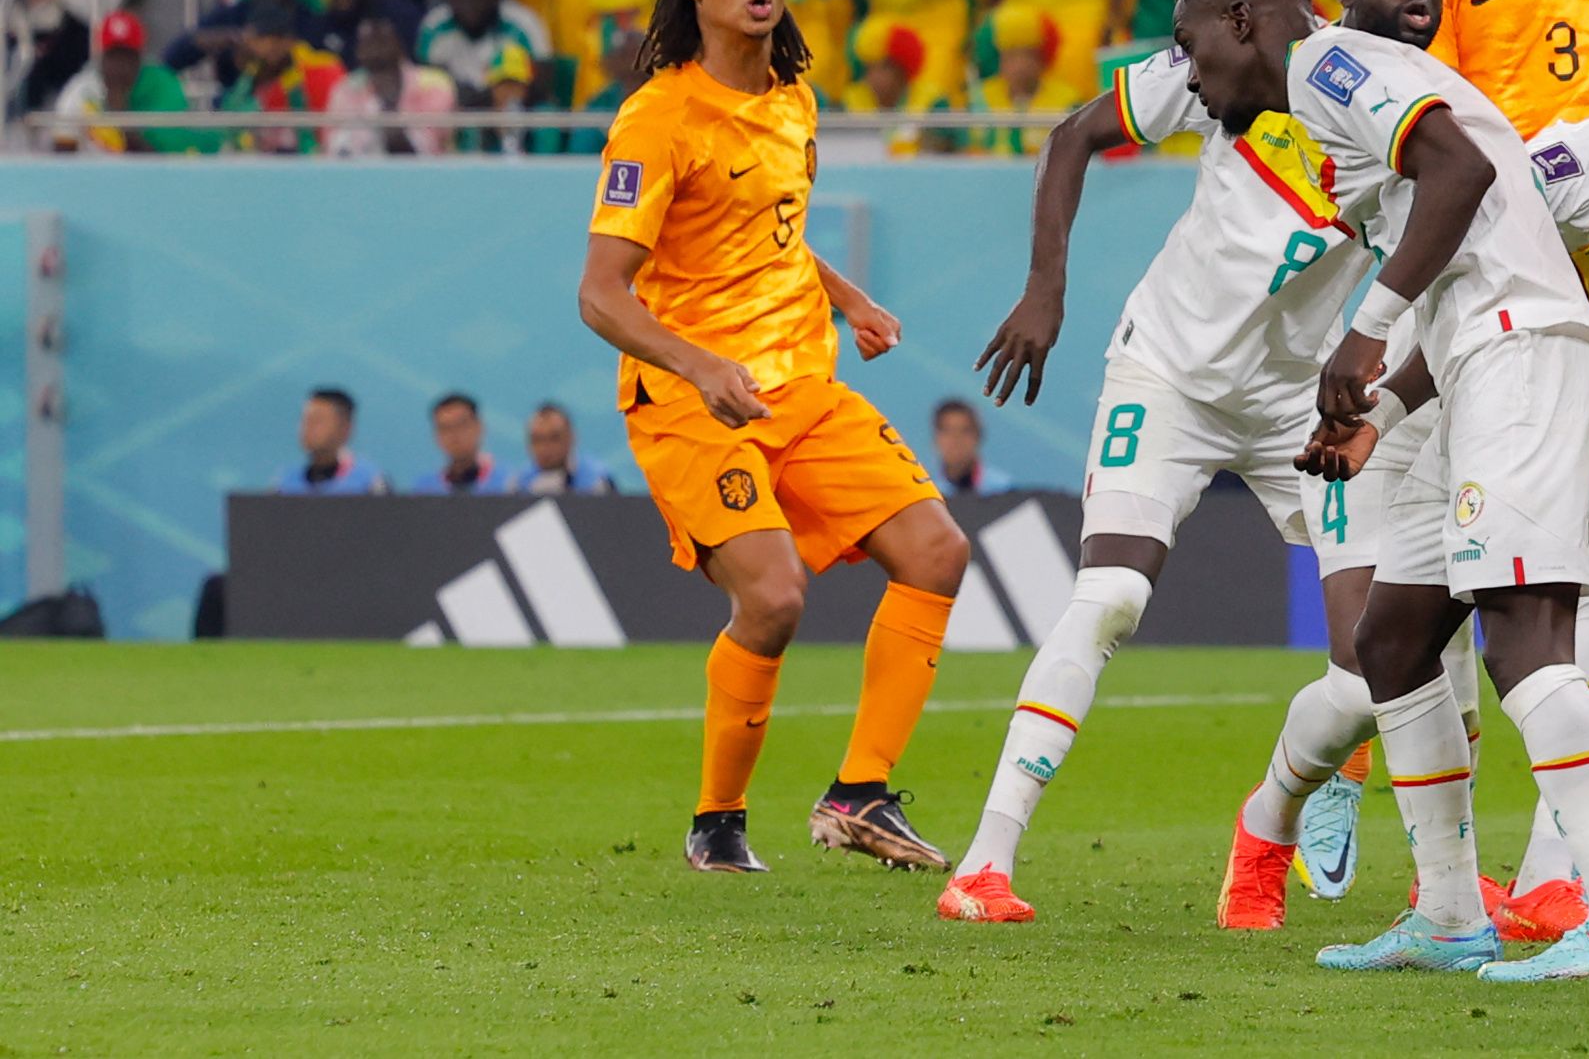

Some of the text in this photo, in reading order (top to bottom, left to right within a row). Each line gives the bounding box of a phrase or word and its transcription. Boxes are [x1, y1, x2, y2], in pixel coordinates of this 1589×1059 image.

[1545, 21, 1579, 82] 3
[772, 197, 795, 250] 5
[1099, 403, 1146, 469] 8
[1321, 477, 1348, 545] 4
[1451, 548, 1481, 565] PUMA
